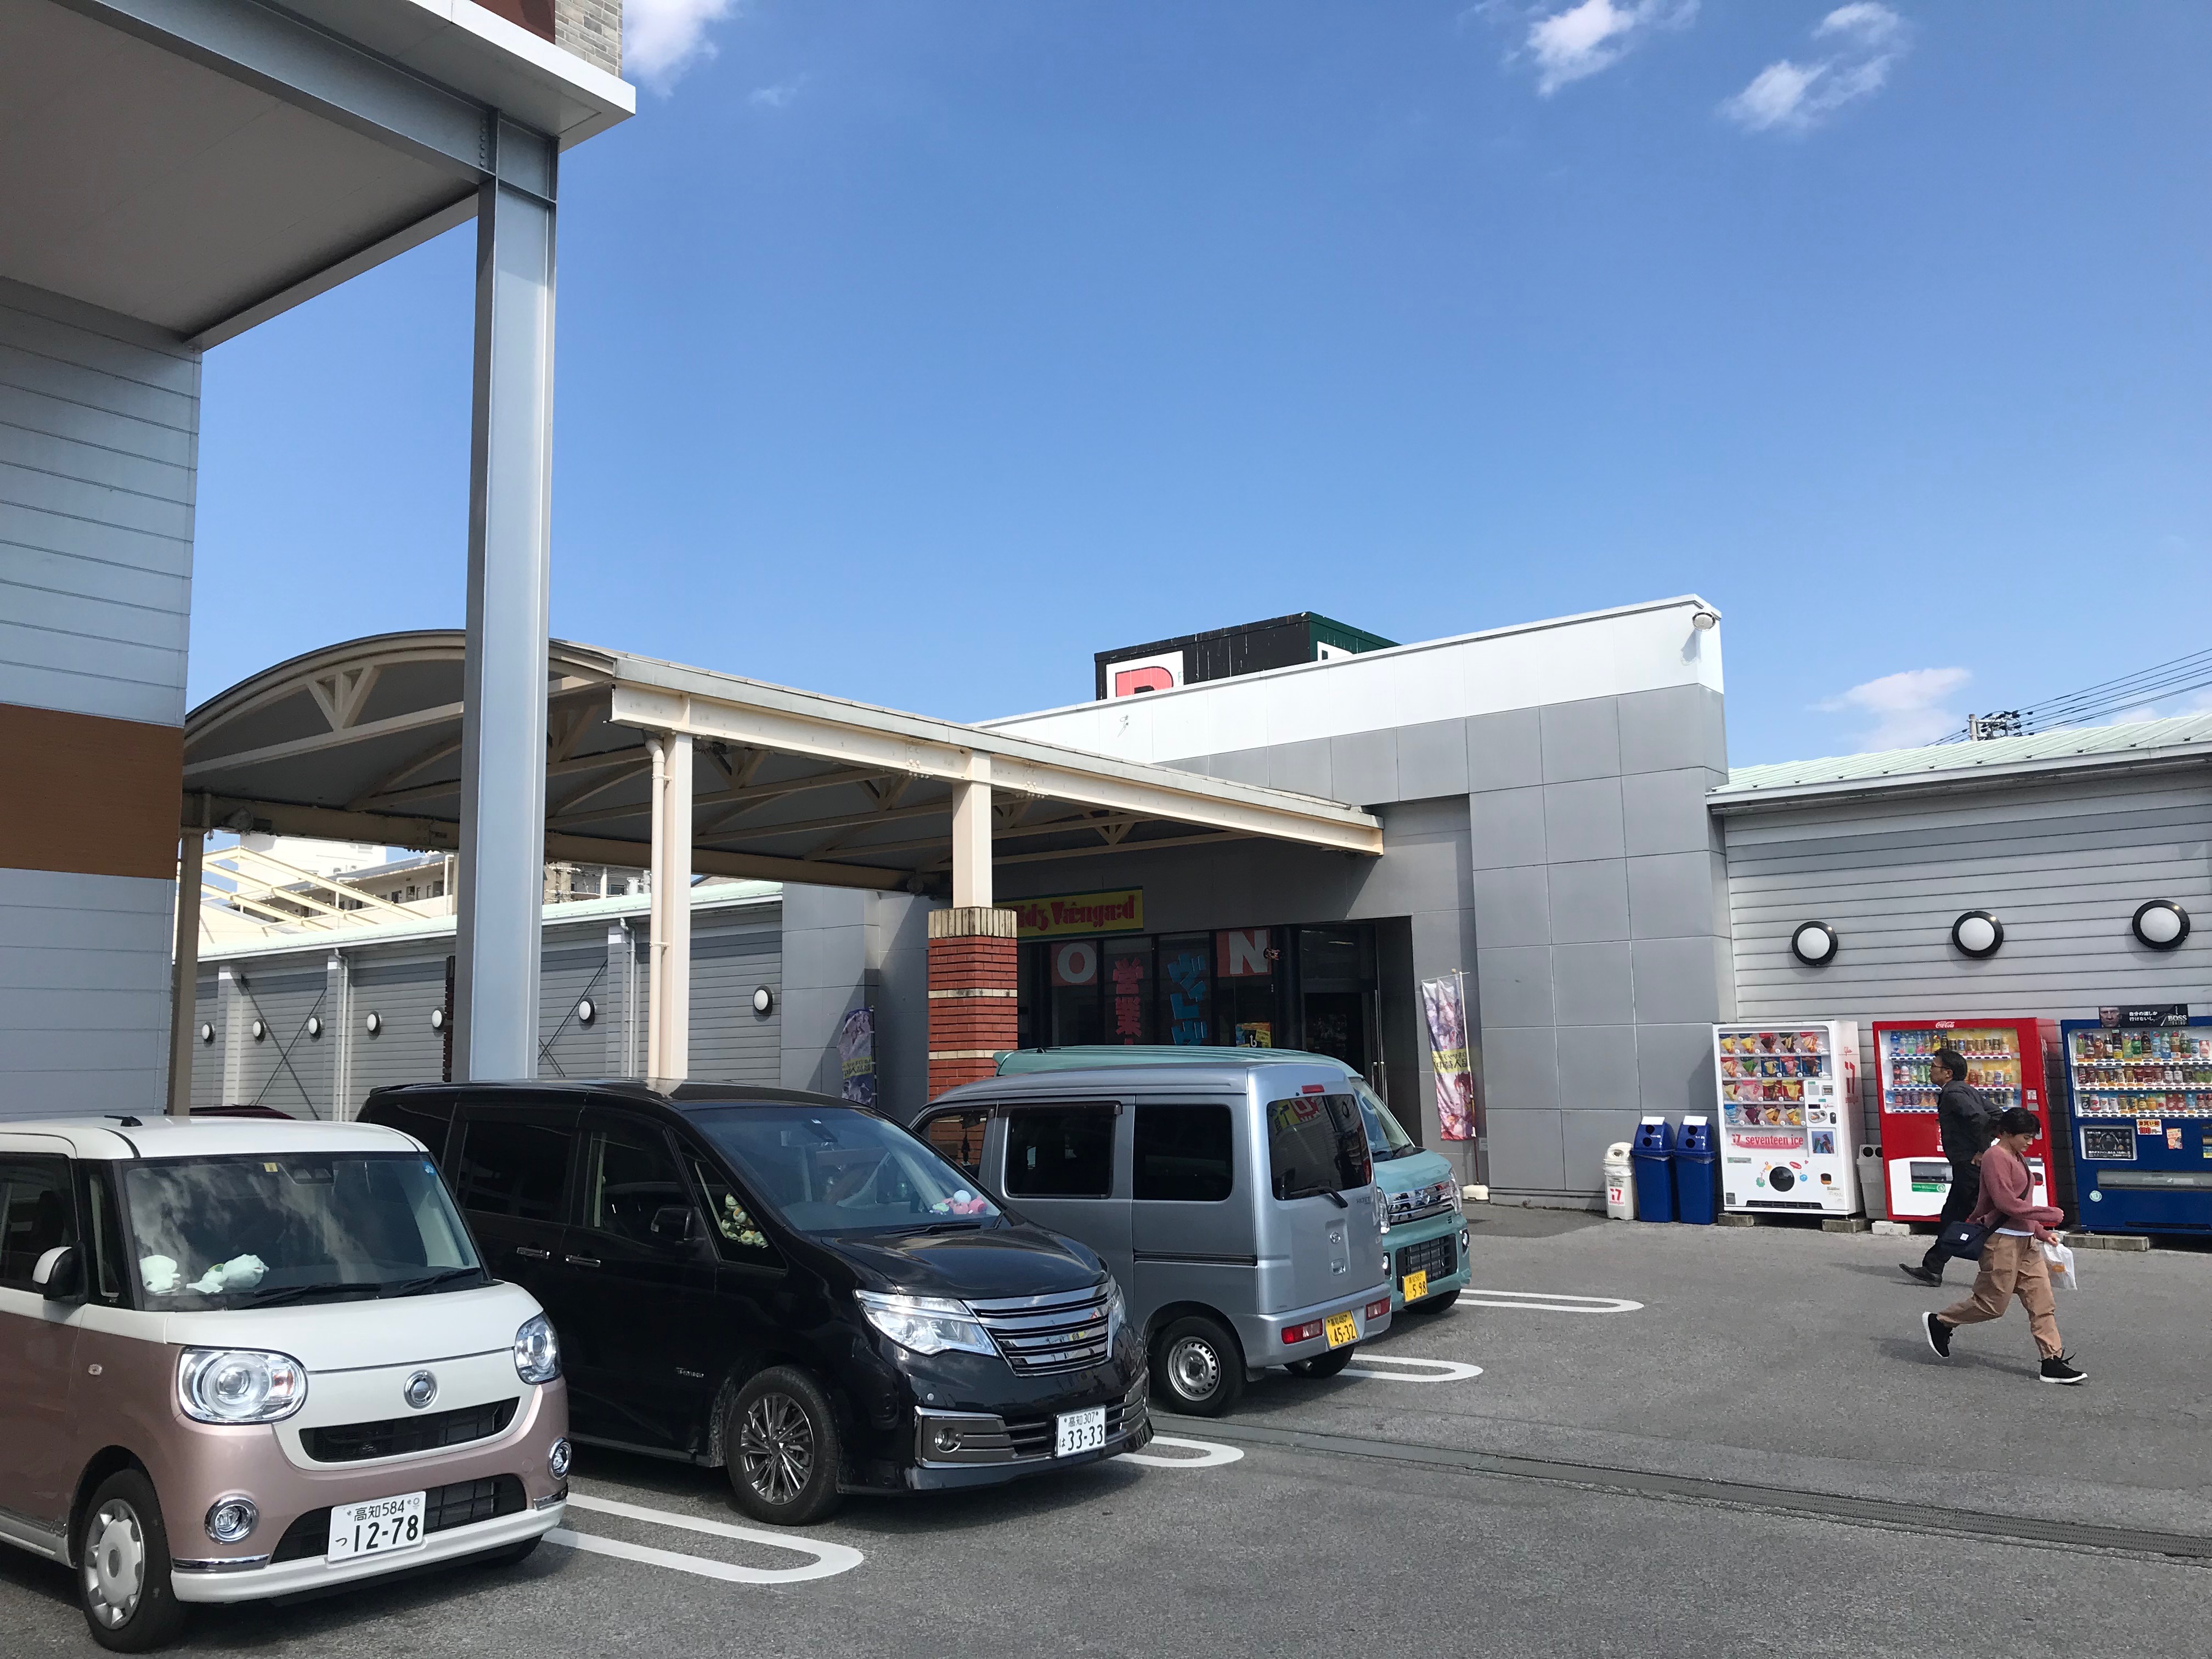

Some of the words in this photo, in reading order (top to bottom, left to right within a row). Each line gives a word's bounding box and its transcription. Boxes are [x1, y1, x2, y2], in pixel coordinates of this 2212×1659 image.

[1058, 943, 1097, 983] O
[1228, 929, 1268, 975] N
[1113, 957, 1144, 1045] 営業
[1746, 1135, 1789, 1146] seventeen
[1791, 1134, 1804, 1146] ice
[1068, 1412, 1095, 1427] 高知307
[1059, 1437, 1065, 1448] は
[1068, 1424, 1103, 1451] 33-33
[354, 1499, 404, 1521] 高知584
[335, 1537, 347, 1547] つ
[354, 1514, 419, 1552] 12-78
